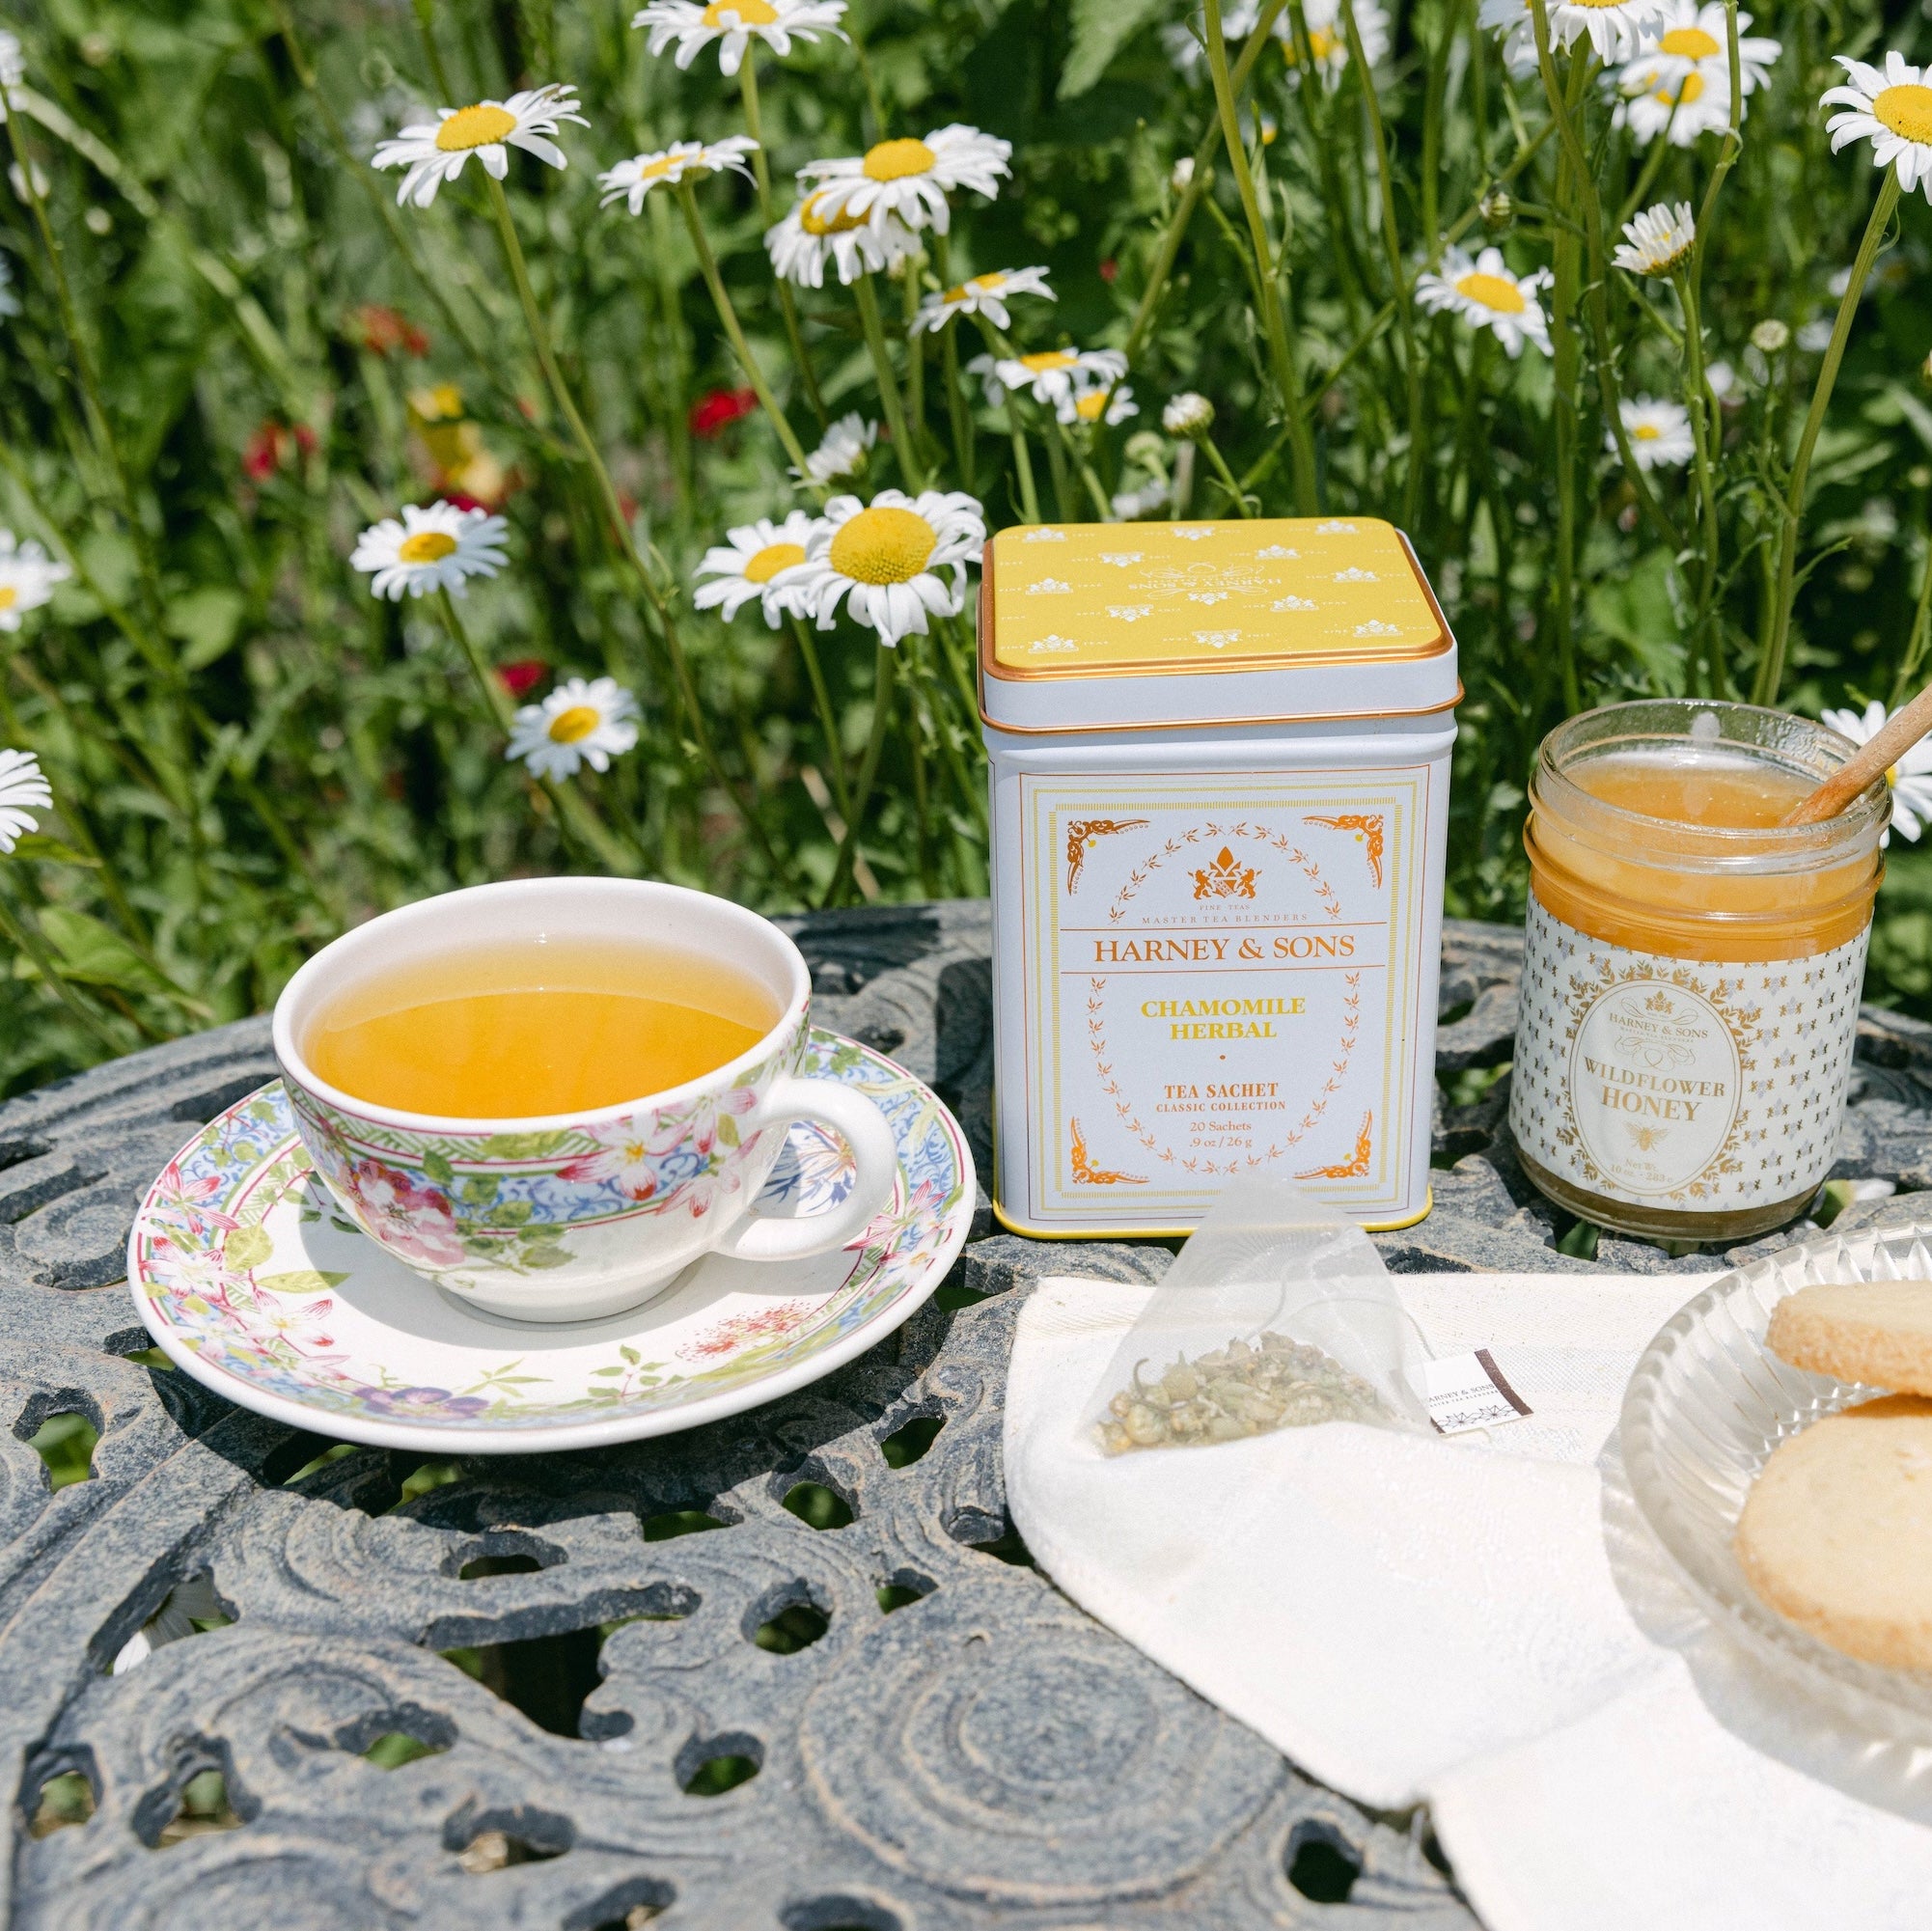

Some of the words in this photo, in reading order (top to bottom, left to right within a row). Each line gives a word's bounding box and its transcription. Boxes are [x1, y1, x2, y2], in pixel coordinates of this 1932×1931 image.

[1235, 913, 1309, 923] BLENDERS
[1092, 938, 1230, 963] HARNEY
[1238, 938, 1266, 960] &
[1272, 934, 1356, 959] SONS
[1140, 997, 1307, 1018] CHAMOMILE
[1169, 1021, 1278, 1041] HERBAL
[1609, 1012, 1660, 1034] HARNEY
[1661, 1025, 1673, 1036] &
[1675, 1027, 1709, 1039] SONS
[1584, 1056, 1725, 1097] WILDFLOWER
[1164, 1085, 1200, 1099] TEA
[1206, 1082, 1280, 1099] SACHET
[1156, 1103, 1206, 1113] CLASSIC
[1210, 1101, 1286, 1112] COLLECTION
[1601, 1085, 1703, 1121] HONEY
[1189, 1121, 1206, 1132] 20
[1208, 1120, 1253, 1132] Sachets
[1189, 1137, 1201, 1147] .9
[1227, 1137, 1243, 1147] 26
[1245, 1140, 1253, 1148] g
[1428, 1391, 1459, 1403] ARNEY
[1470, 1383, 1496, 1393] SONS
